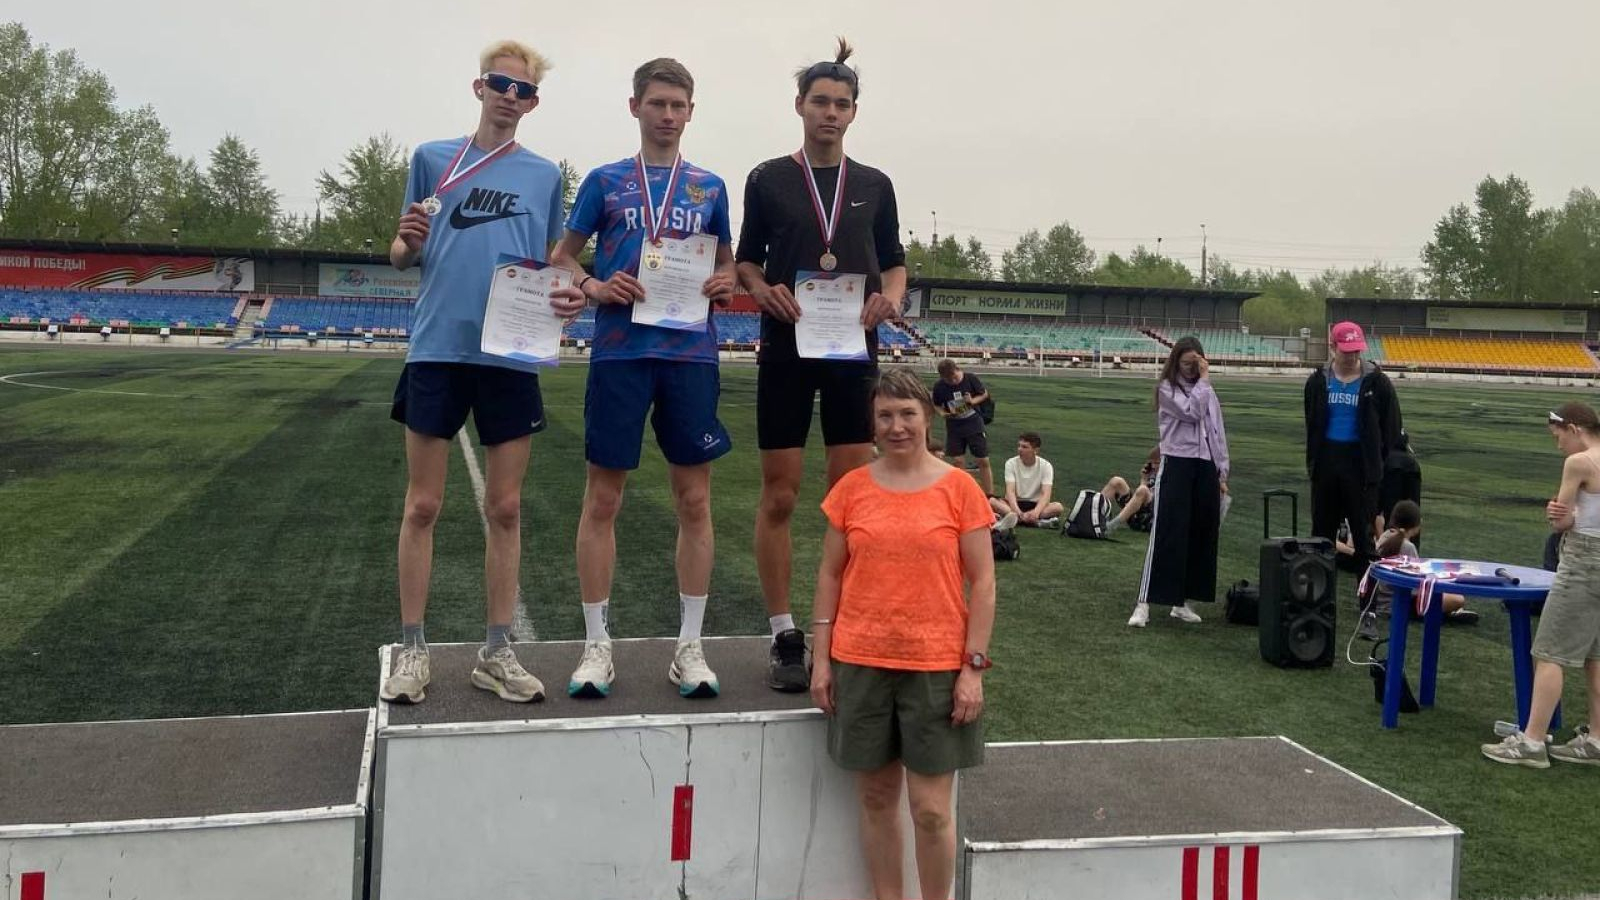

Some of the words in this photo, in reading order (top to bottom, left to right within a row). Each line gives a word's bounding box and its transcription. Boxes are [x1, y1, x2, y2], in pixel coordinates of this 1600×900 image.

[463, 188, 520, 214] NIKE
[932, 295, 968, 306] СПОРТ
[979, 297, 1020, 309] НОРМА
[1024, 299, 1064, 311] ЖИЗНИ
